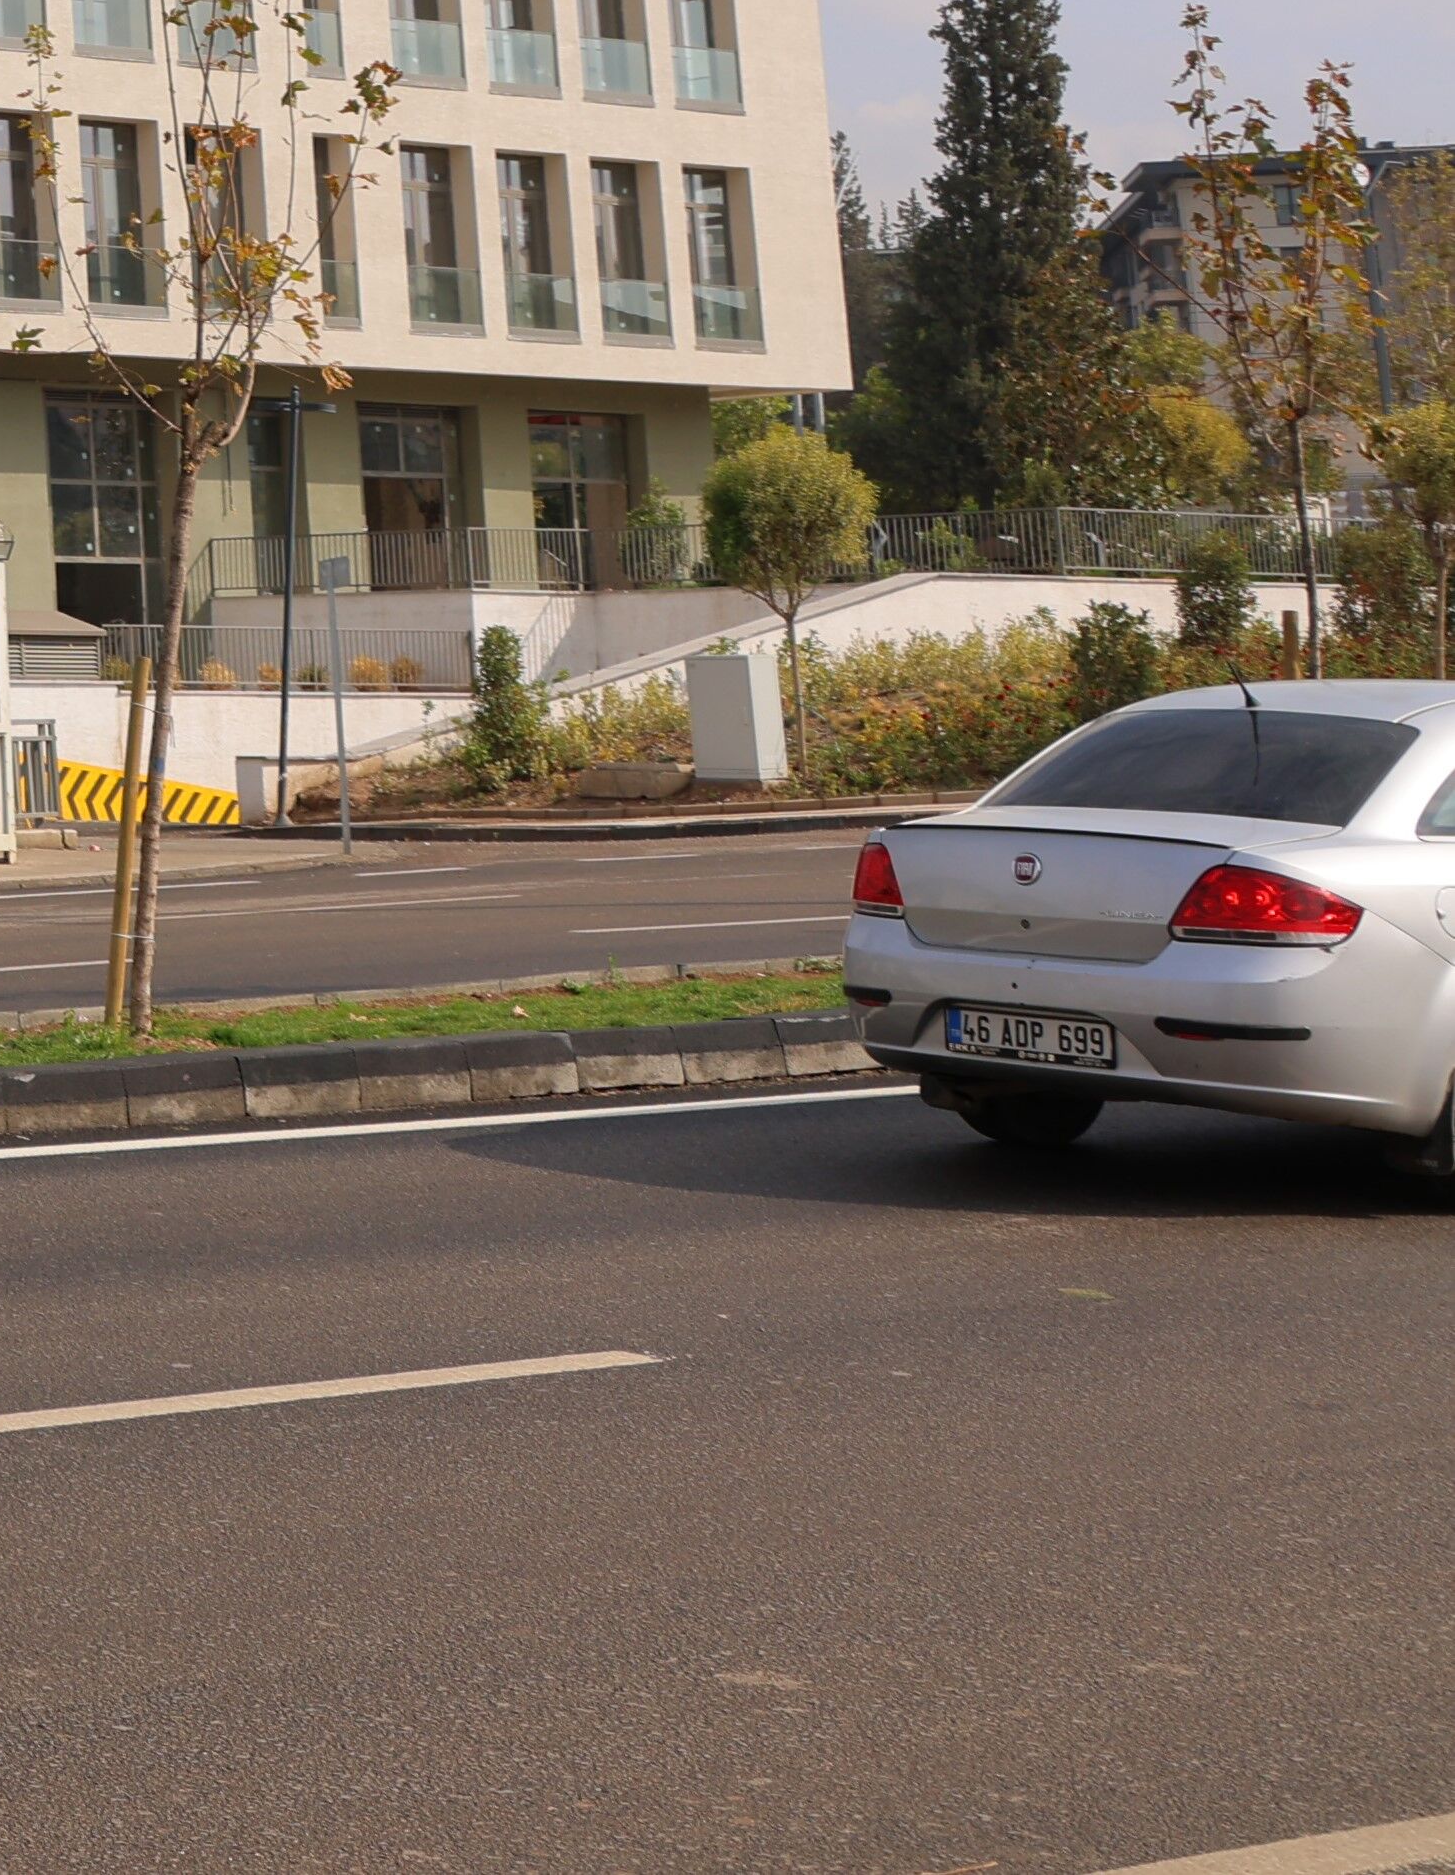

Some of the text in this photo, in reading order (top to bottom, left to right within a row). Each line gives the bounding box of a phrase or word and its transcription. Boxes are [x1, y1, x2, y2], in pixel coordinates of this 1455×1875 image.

[963, 1014, 1104, 1056] 46 ADP 699
